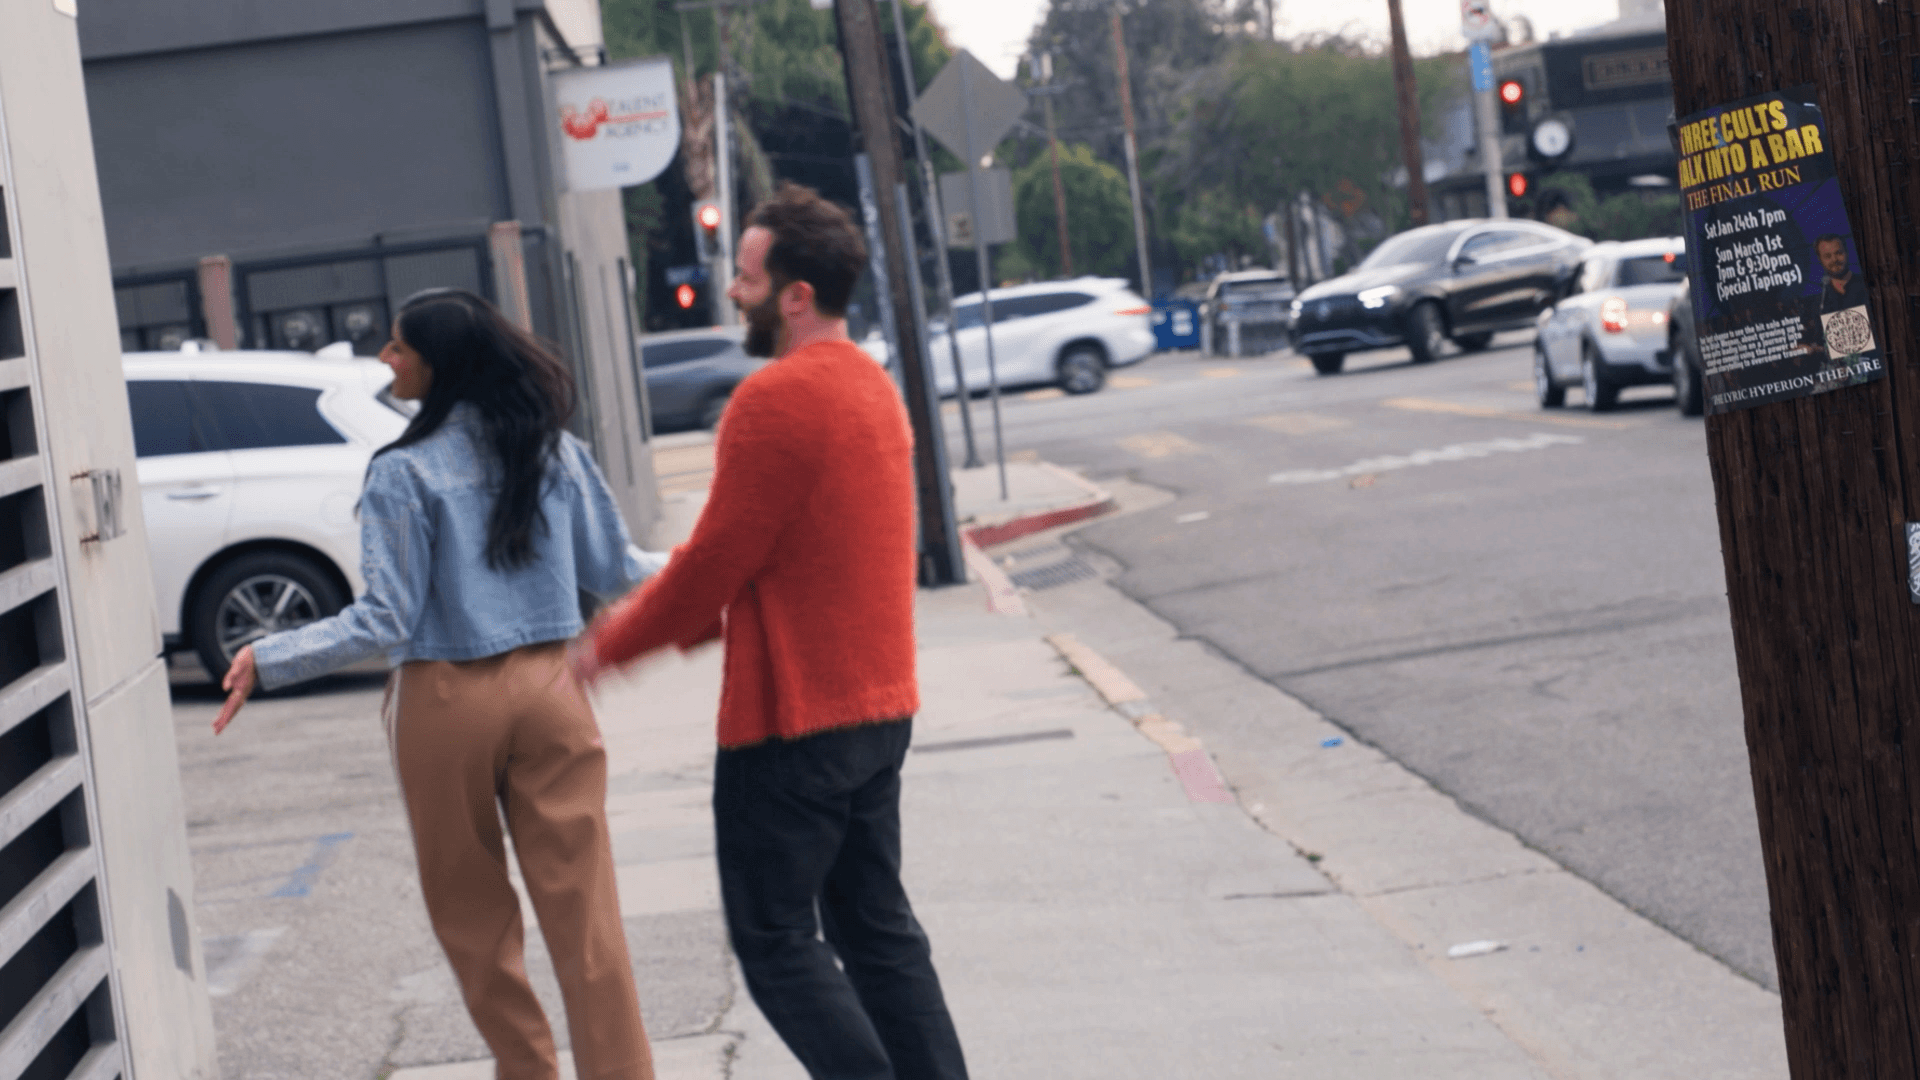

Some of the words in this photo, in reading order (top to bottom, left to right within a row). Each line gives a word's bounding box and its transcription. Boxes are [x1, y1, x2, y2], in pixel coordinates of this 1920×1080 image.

[608, 93, 666, 114] TALENT
[605, 120, 668, 138] AGENCY
[1720, 99, 1788, 143] CULTS
[1679, 153, 1706, 189] ALK
[1705, 142, 1747, 180] INTO
[1750, 138, 1769, 169] A
[1767, 124, 1823, 164] BAR
[1687, 189, 1709, 211] THE
[1710, 177, 1756, 204] FINAL
[1758, 165, 1801, 192] RUN
[1705, 223, 1717, 239] Sat
[1717, 220, 1733, 236] Jan
[1732, 212, 1758, 232] 24th
[1758, 208, 1786, 228] 7pm
[1716, 247, 1733, 263] Sun
[1733, 238, 1764, 259] March
[1765, 235, 1783, 251] 1st
[1716, 265, 1736, 283] 7pm
[1736, 260, 1745, 275] &
[1746, 254, 1791, 273] 9:30pm
[1717, 275, 1751, 302] (Special
[1751, 264, 1802, 291] Tapings)
[1745, 326, 1755, 334] the
[1755, 323, 1765, 331] hit
[1766, 320, 1780, 329] solo
[1781, 317, 1800, 326] show
[1759, 328, 1785, 340] growing
[1786, 326, 1796, 334] up
[1756, 348, 1766, 356] the
[1767, 344, 1788, 355] power
[1790, 340, 1797, 348] of
[1783, 348, 1807, 358] trauma
[1724, 389, 1749, 404] LYRIC
[1749, 374, 1813, 398] HYPERION
[1816, 358, 1882, 383] THEATRE
